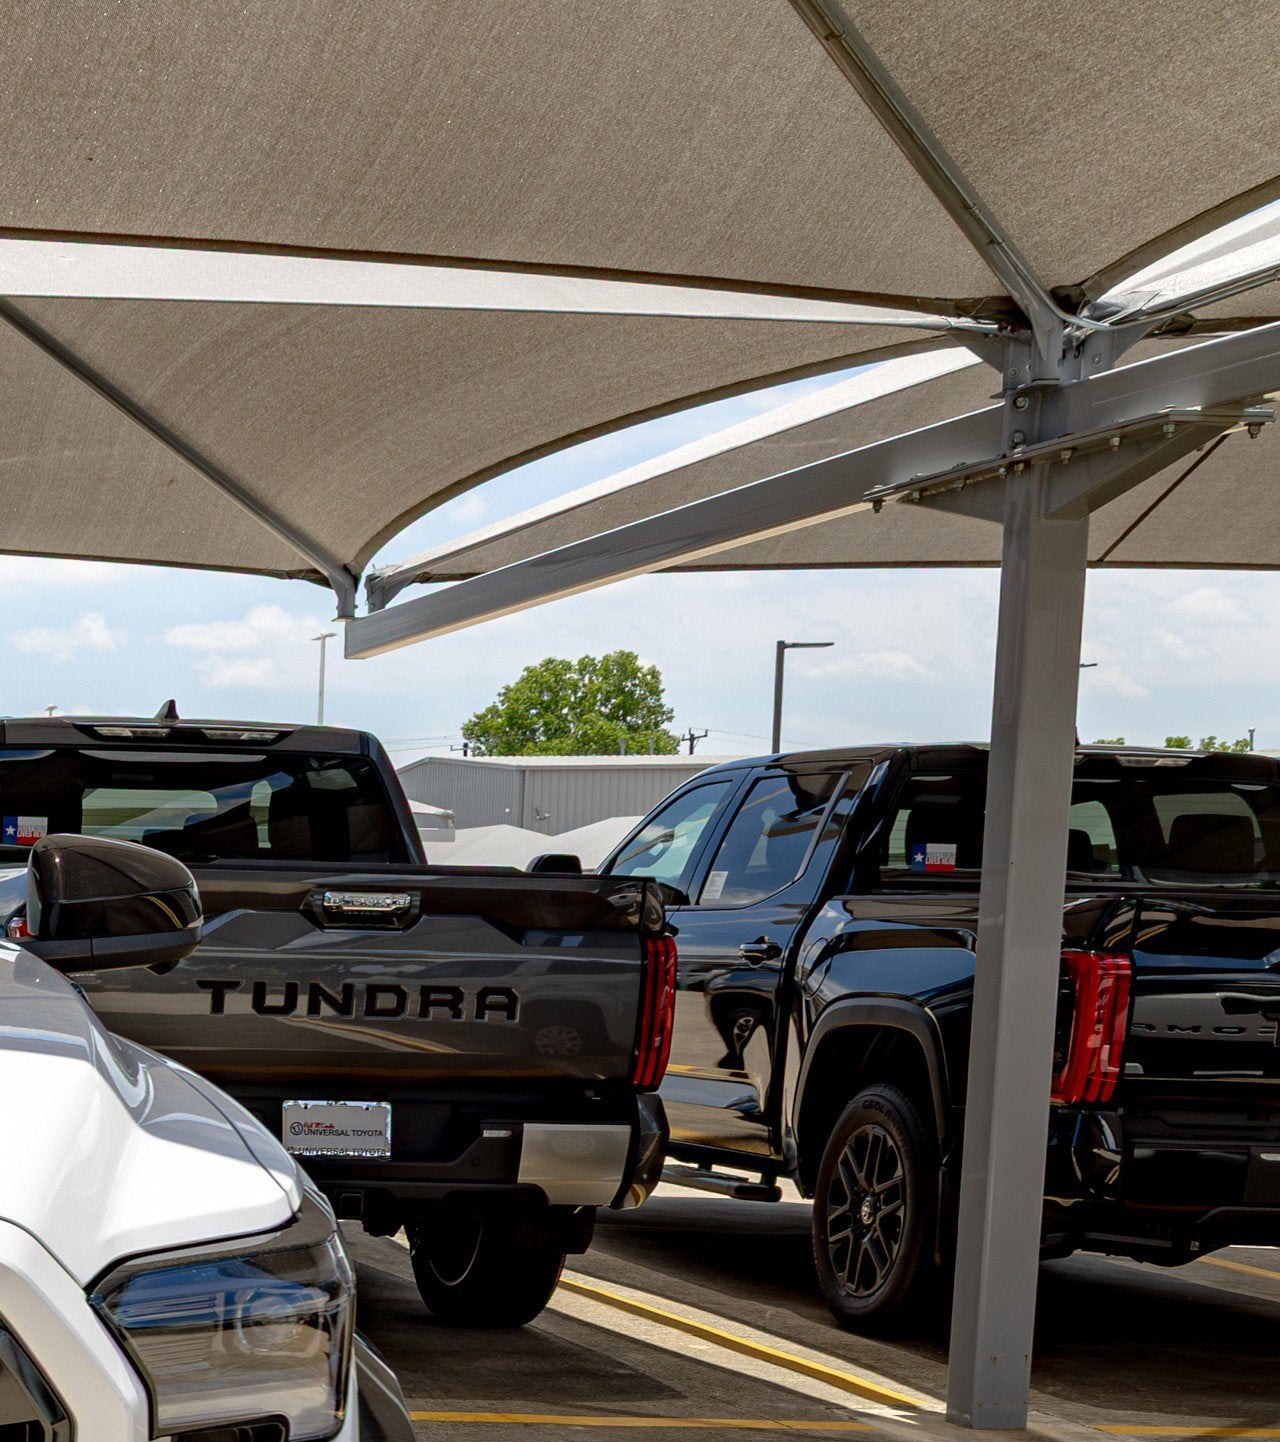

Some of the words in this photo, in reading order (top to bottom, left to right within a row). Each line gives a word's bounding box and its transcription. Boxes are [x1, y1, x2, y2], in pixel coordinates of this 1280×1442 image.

[193, 978, 520, 1022] TUNDRA
[303, 1129, 350, 1137] UNIVERSAL
[298, 1147, 349, 1156] UNIVERSAL
[352, 1147, 387, 1157] TOYOTA
